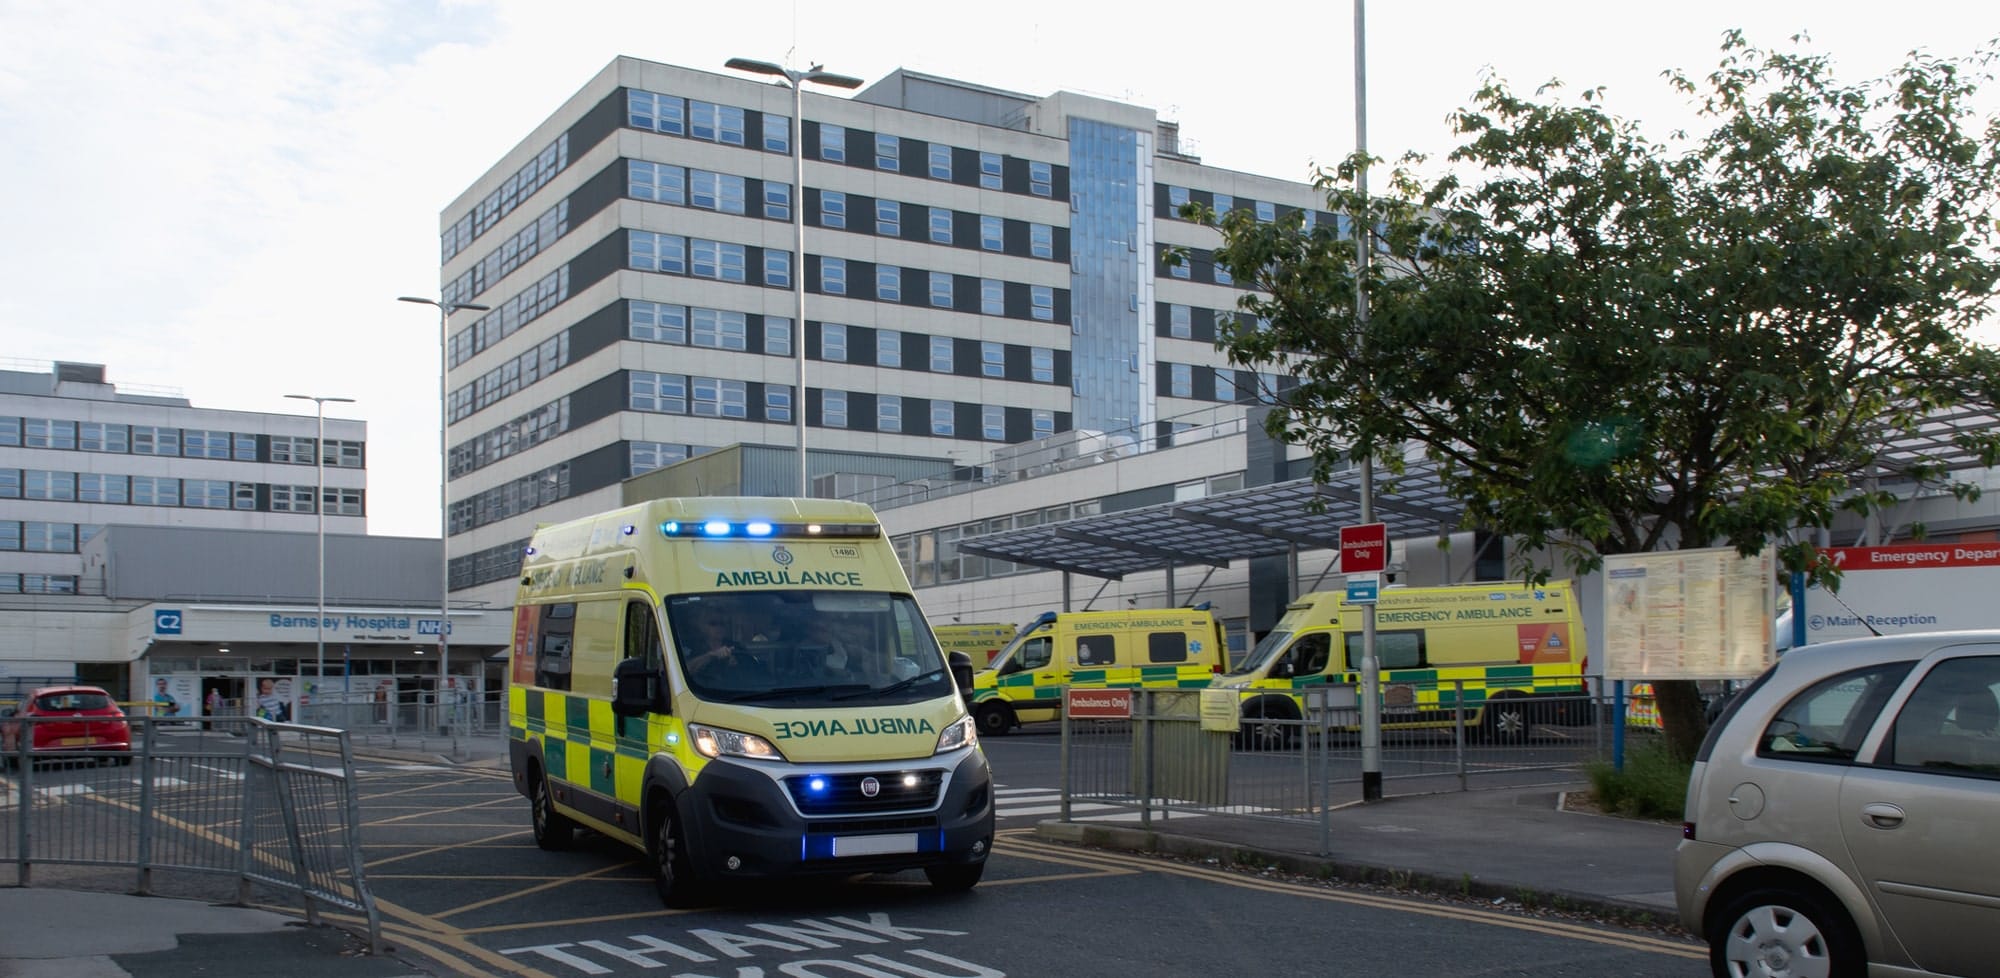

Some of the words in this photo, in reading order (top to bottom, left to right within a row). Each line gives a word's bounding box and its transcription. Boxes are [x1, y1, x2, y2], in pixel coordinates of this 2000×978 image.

[1343, 540, 1383, 549] Ambulances
[1354, 550, 1371, 559] Only
[1871, 550, 1950, 564] Emergency
[716, 571, 863, 587] AMBULANCE
[1378, 597, 1411, 605] orkshire
[157, 615, 181, 629] C2
[1378, 610, 1452, 623] EMERGENCY
[1456, 607, 1533, 620] AMBULANCE
[1827, 615, 1861, 627] Main
[1867, 613, 1937, 627] Reception
[270, 613, 341, 631] Barnsey
[346, 615, 411, 632] Hospital
[1074, 622, 1128, 631] EMERGENCY
[1130, 619, 1184, 628] AMBULANCE
[1071, 697, 1111, 707] Ambulances
[1112, 697, 1128, 709] Only
[498, 912, 968, 975] THANK
